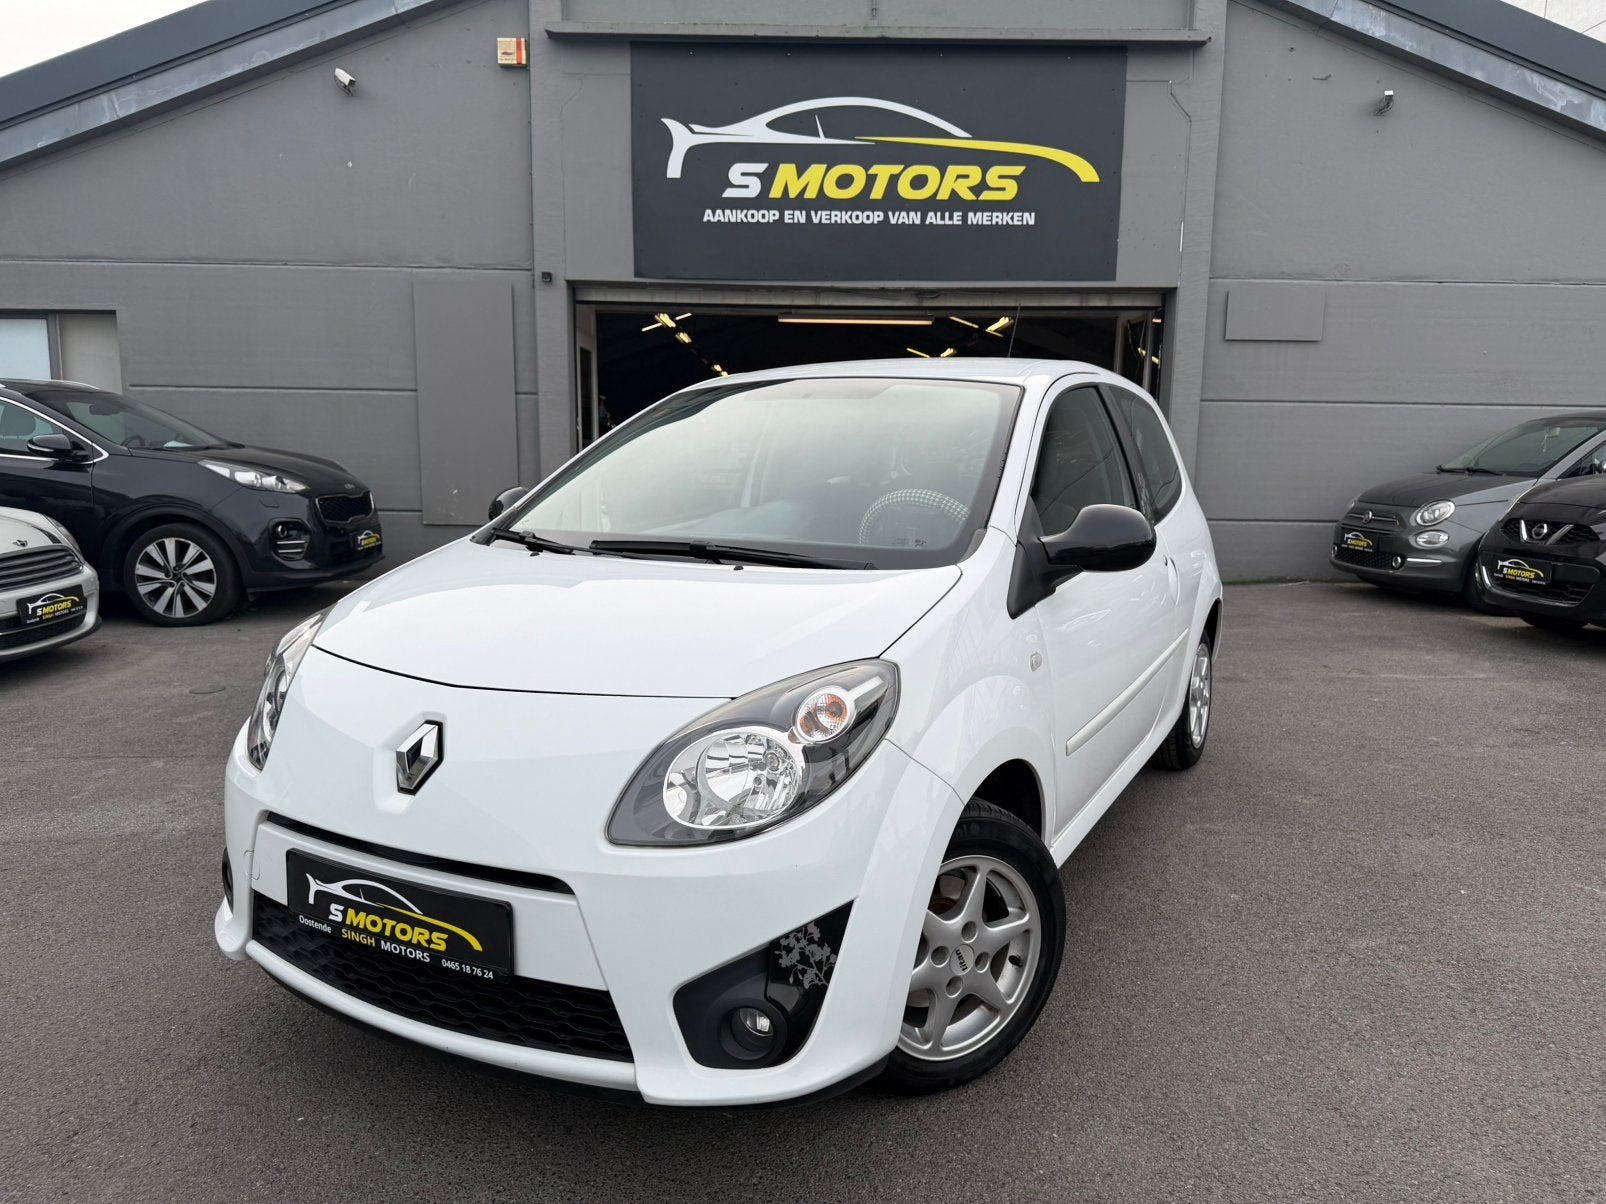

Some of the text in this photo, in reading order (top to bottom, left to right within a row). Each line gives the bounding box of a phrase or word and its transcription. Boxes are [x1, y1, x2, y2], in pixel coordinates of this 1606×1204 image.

[721, 162, 1026, 200] S MOTORS
[703, 209, 1036, 225] AANKOOP EN VERKOOP VAN ALLE MERKEN
[1507, 568, 1536, 579] MOTORS
[43, 600, 72, 614] MOTORS
[299, 914, 332, 934] Oostende
[328, 903, 449, 952] S MOTORS
[341, 928, 431, 963] SINGH MOTORS
[441, 958, 494, 980] 0465 18 76 24
[955, 949, 968, 971] titan
